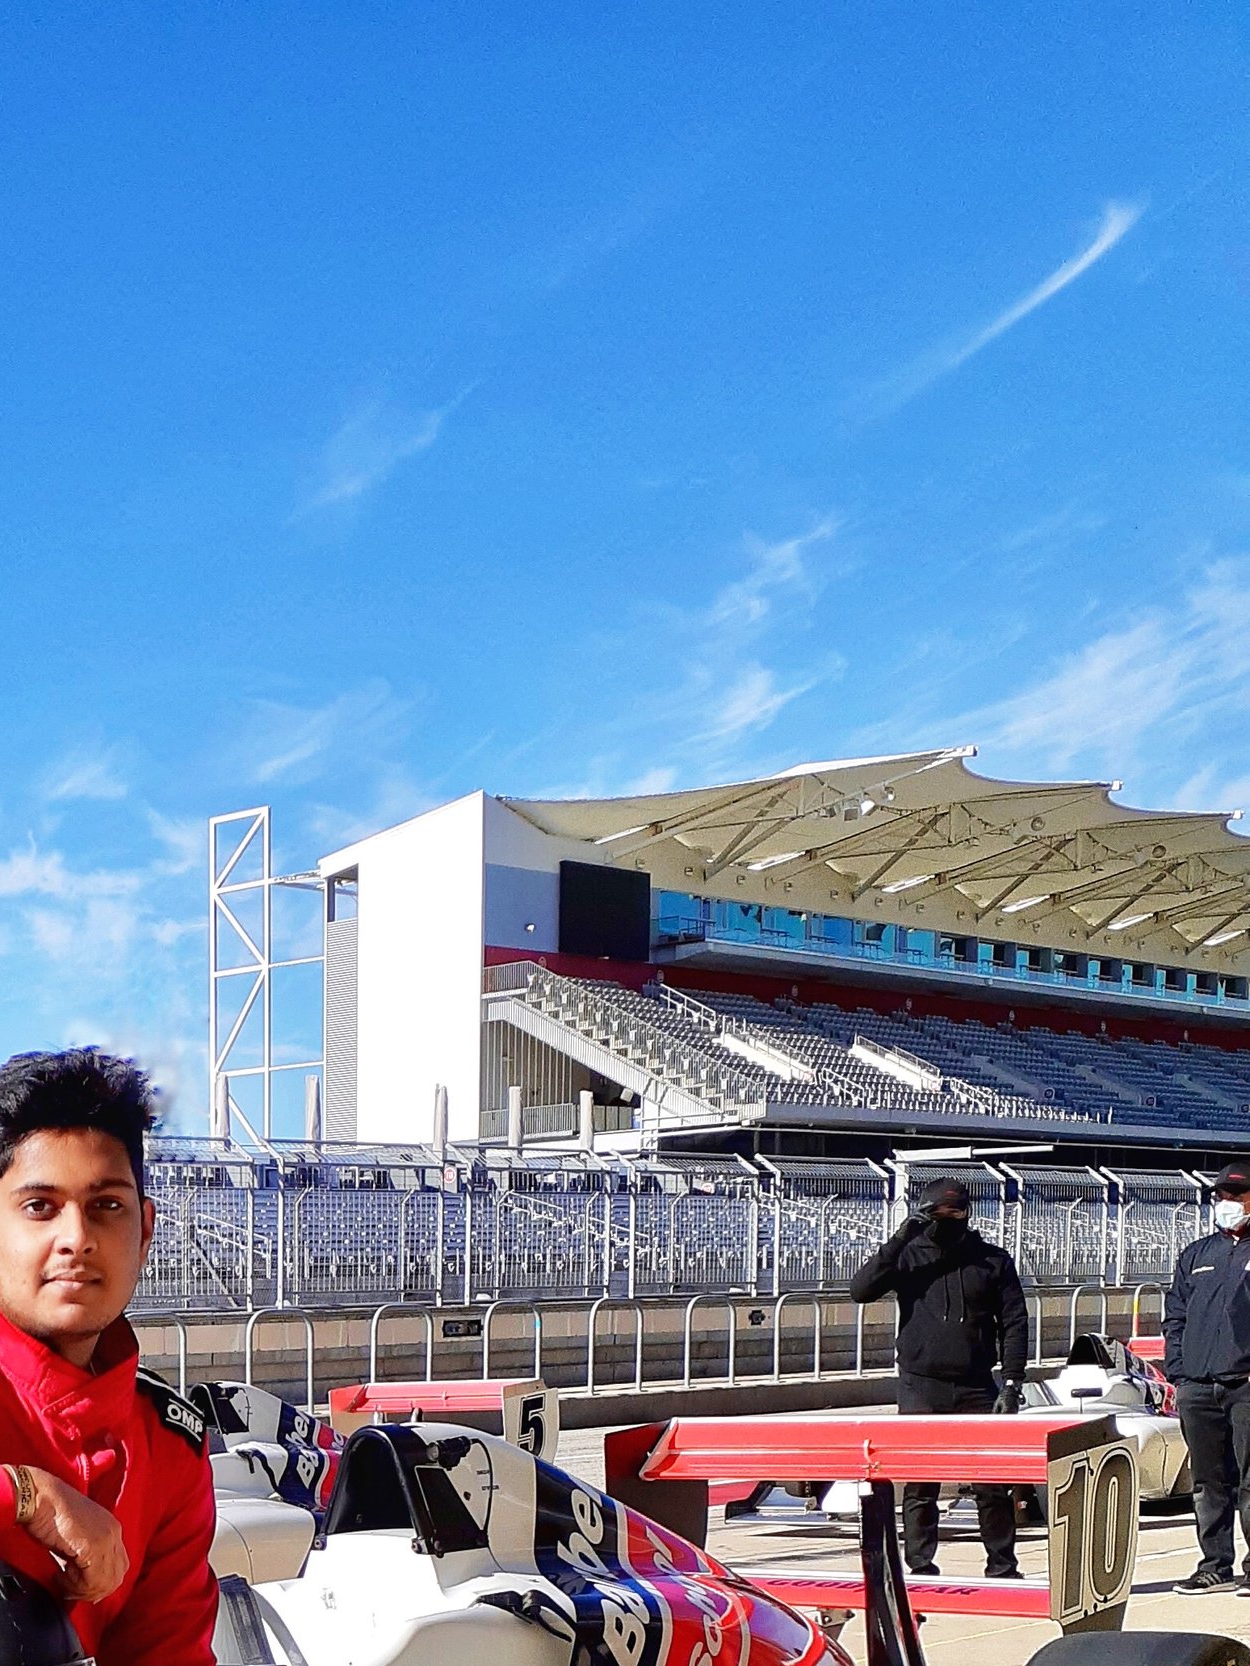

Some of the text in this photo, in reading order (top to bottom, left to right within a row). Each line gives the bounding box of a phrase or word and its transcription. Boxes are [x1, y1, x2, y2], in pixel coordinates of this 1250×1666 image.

[166, 1403, 204, 1434] OMP
[517, 1393, 546, 1458] 5
[1053, 1446, 1136, 1618] 10
